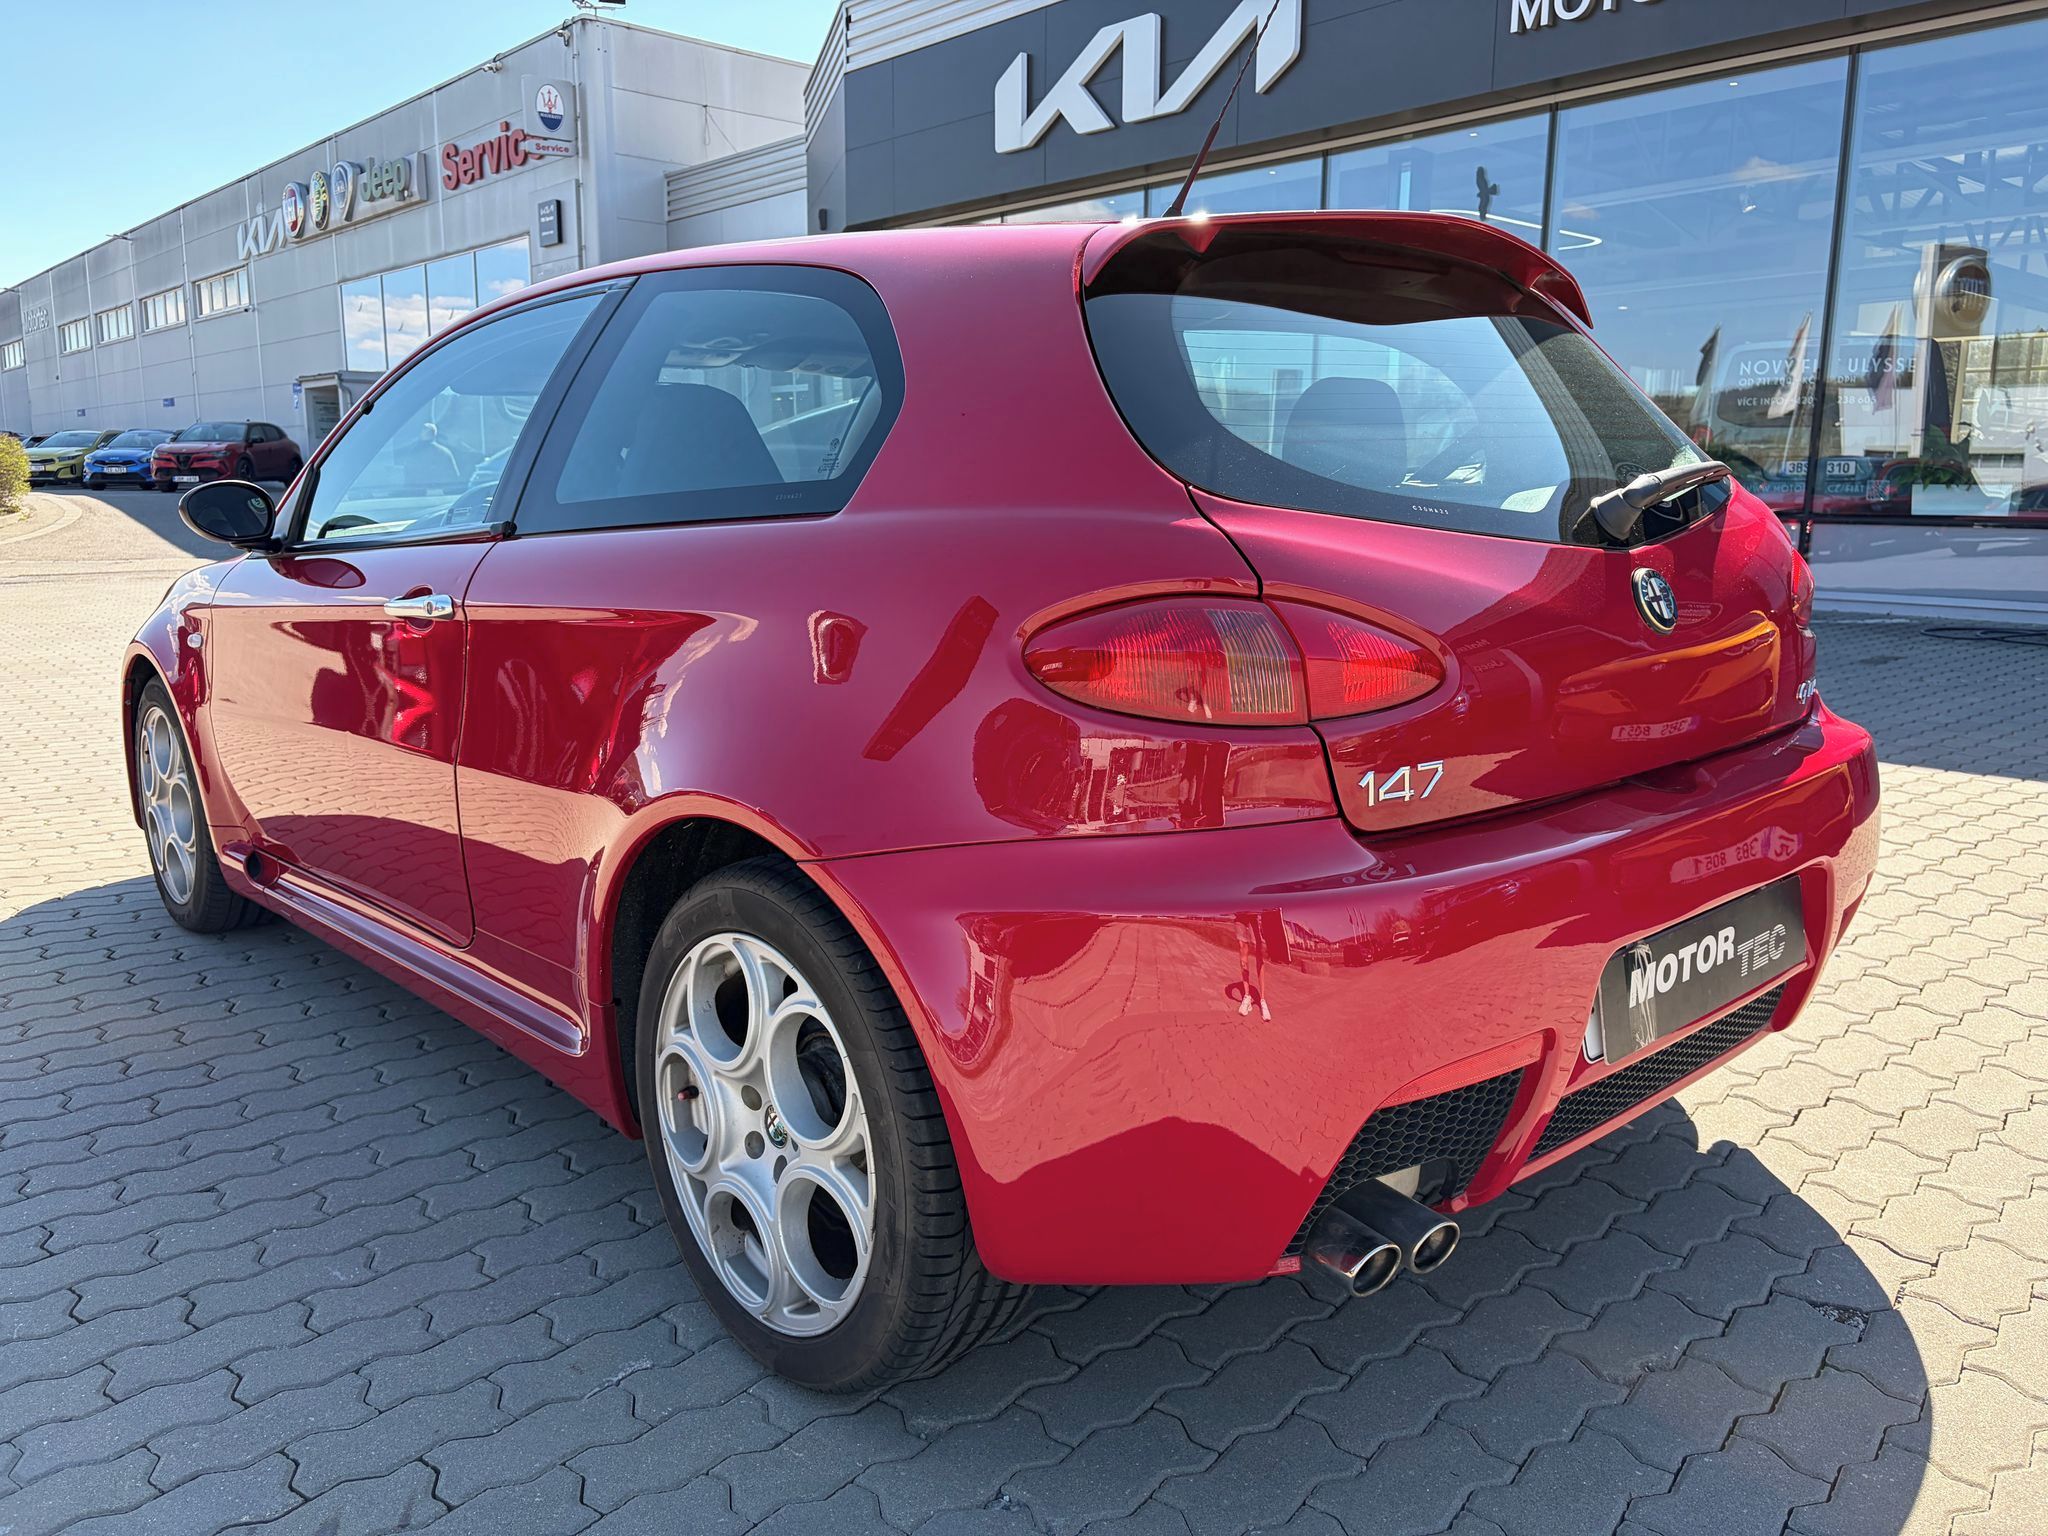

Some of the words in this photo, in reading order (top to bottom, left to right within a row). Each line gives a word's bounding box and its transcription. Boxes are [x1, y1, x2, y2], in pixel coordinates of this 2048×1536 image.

[994, 0, 1301, 154] KIA
[535, 142, 569, 153] Service
[360, 157, 410, 201] Jeep
[1848, 357, 1917, 373] ULYSSE
[1358, 760, 1444, 807] 147
[1629, 926, 1736, 1009] MOTOR
[1736, 923, 1787, 978] TEC
